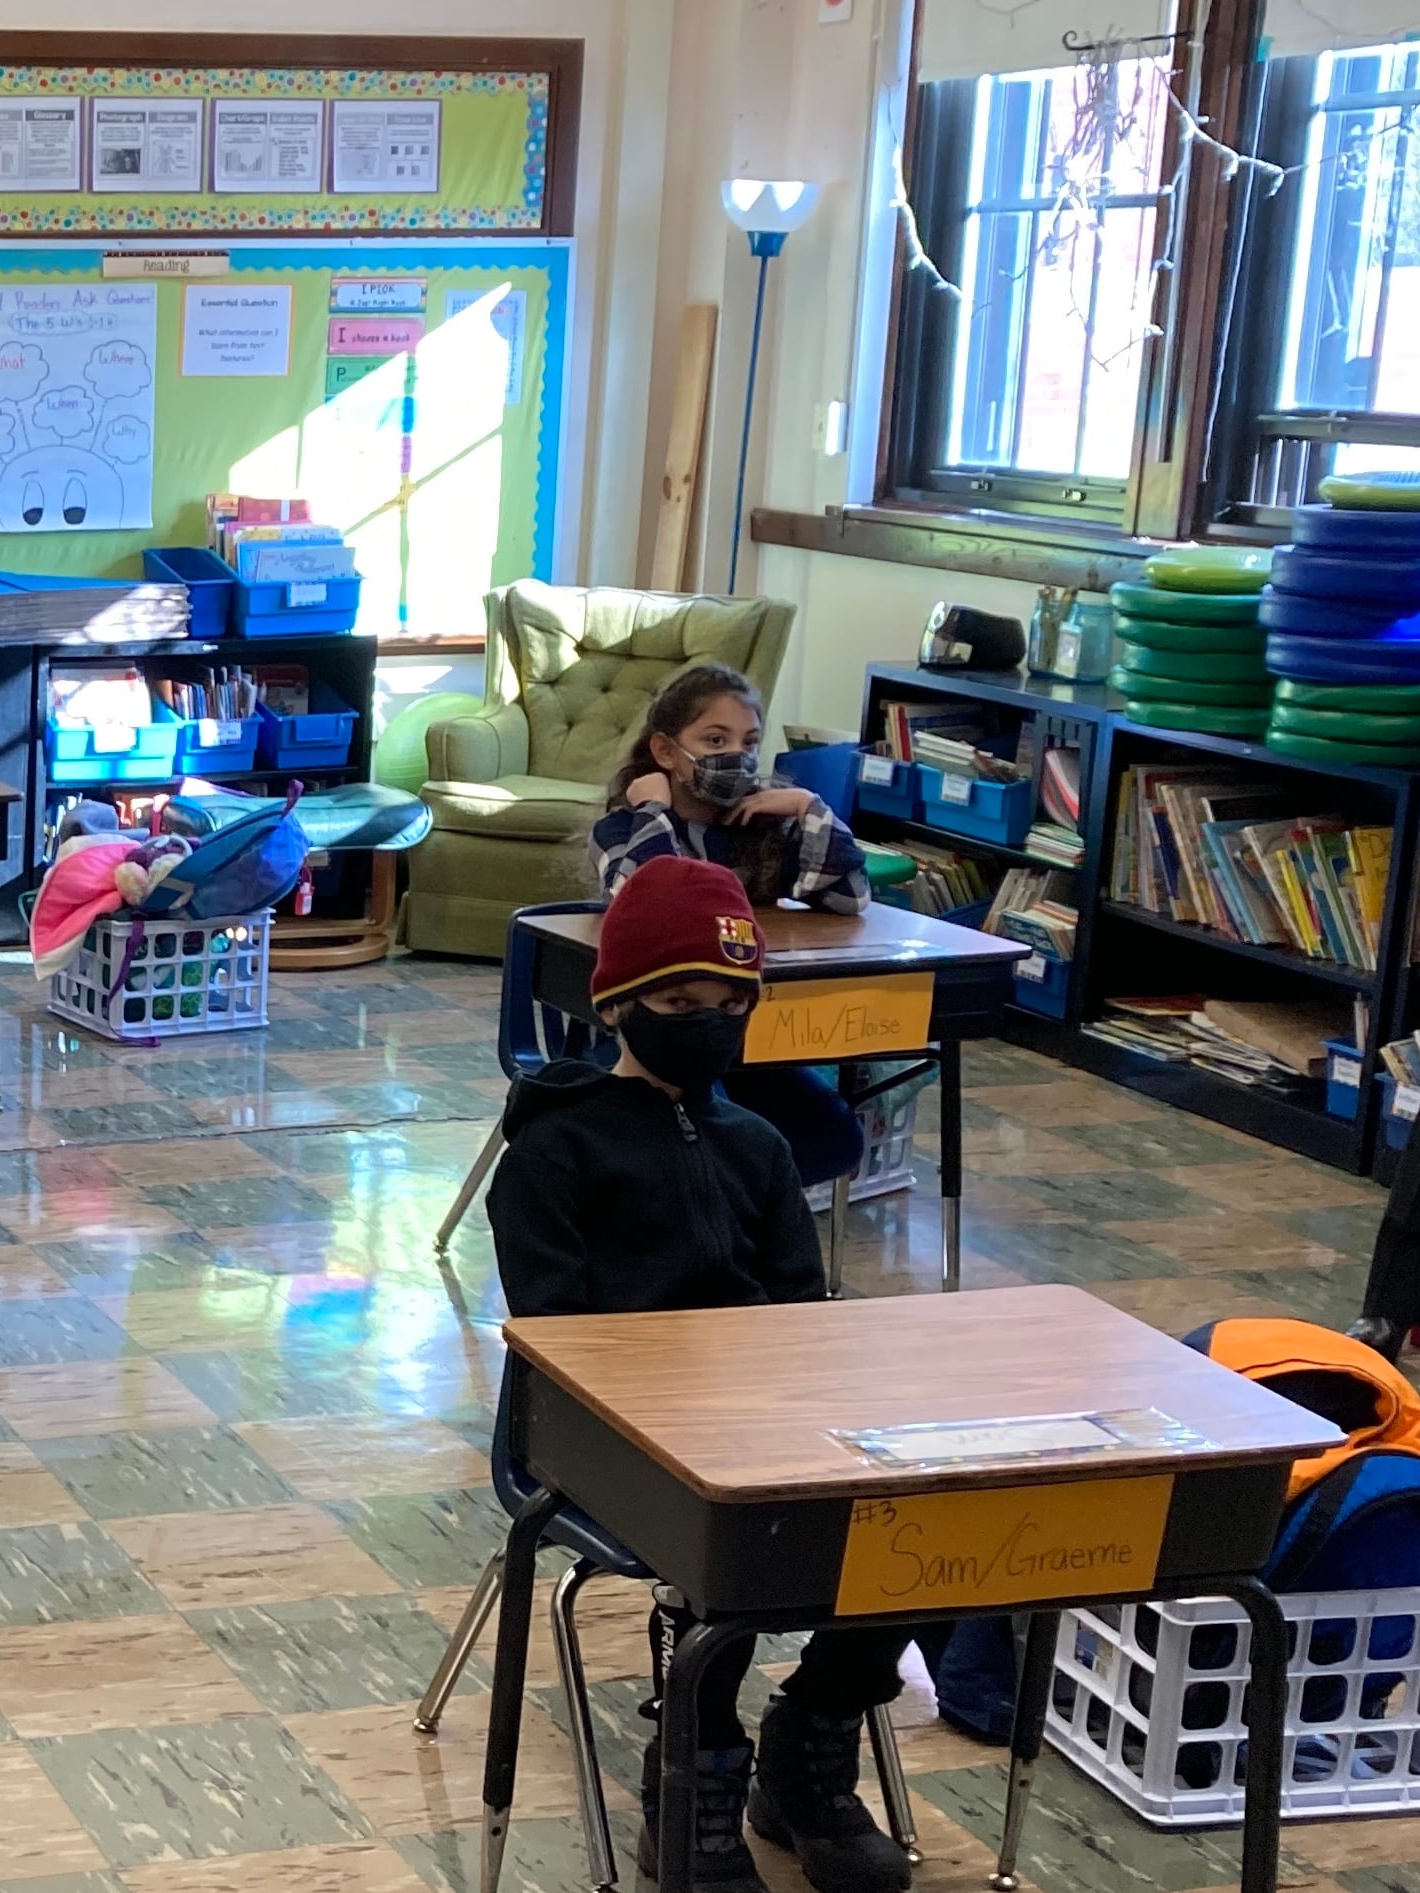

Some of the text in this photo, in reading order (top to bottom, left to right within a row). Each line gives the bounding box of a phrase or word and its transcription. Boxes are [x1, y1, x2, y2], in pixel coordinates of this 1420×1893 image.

[143, 258, 190, 273] Reading
[338, 326, 346, 343] I
[851, 1500, 898, 1526] #3
[879, 1511, 1132, 1597] Sam/Graeme
